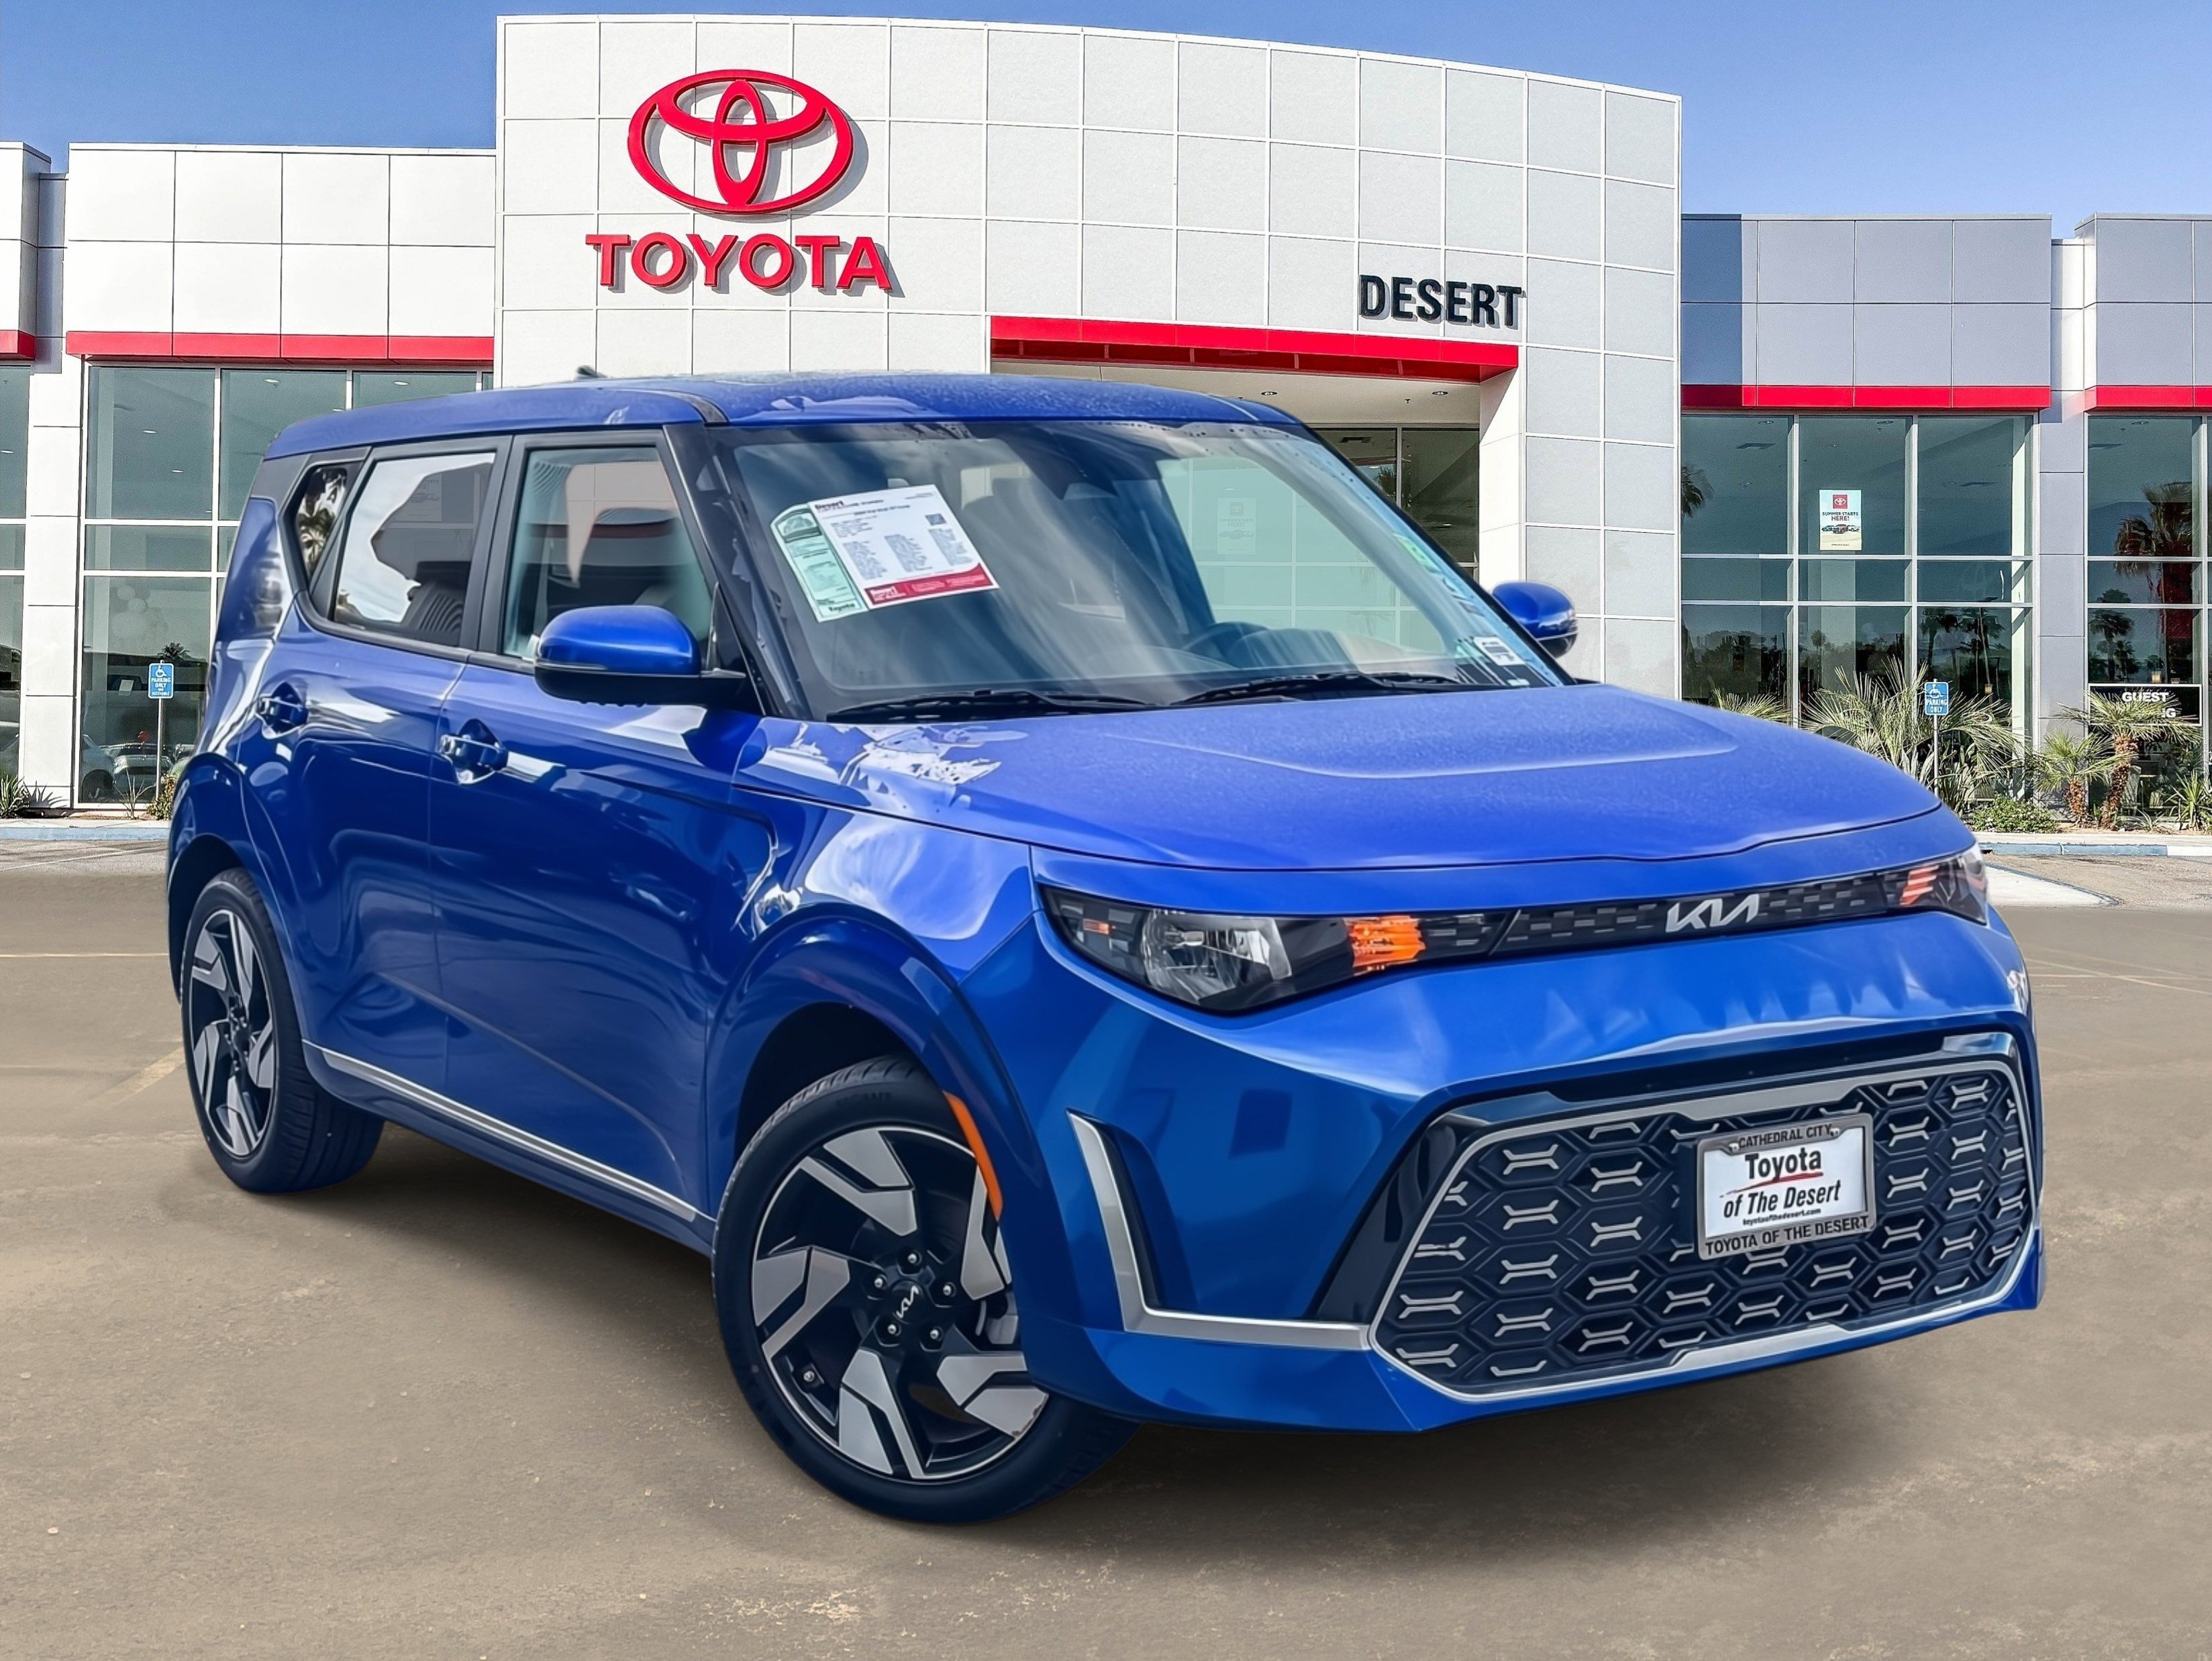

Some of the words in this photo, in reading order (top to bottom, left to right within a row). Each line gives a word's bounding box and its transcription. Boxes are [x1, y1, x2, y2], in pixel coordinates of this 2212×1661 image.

[586, 232, 892, 290] TOYOTA
[1359, 274, 1522, 326] DESERT
[2122, 692, 2169, 703] GUEST
[1739, 1128, 1803, 1149] CATHEDRAL
[1806, 1123, 1832, 1138] CITY
[1745, 1148, 1821, 1182] Toyota
[1723, 1195, 1743, 1218] of
[1748, 1191, 1778, 1215] The
[1784, 1180, 1841, 1209] Desert
[1705, 1236, 1758, 1256] TOYOTA
[1762, 1229, 1780, 1245] OF
[1784, 1224, 1811, 1241] THE
[1815, 1215, 1869, 1237] DESERT
